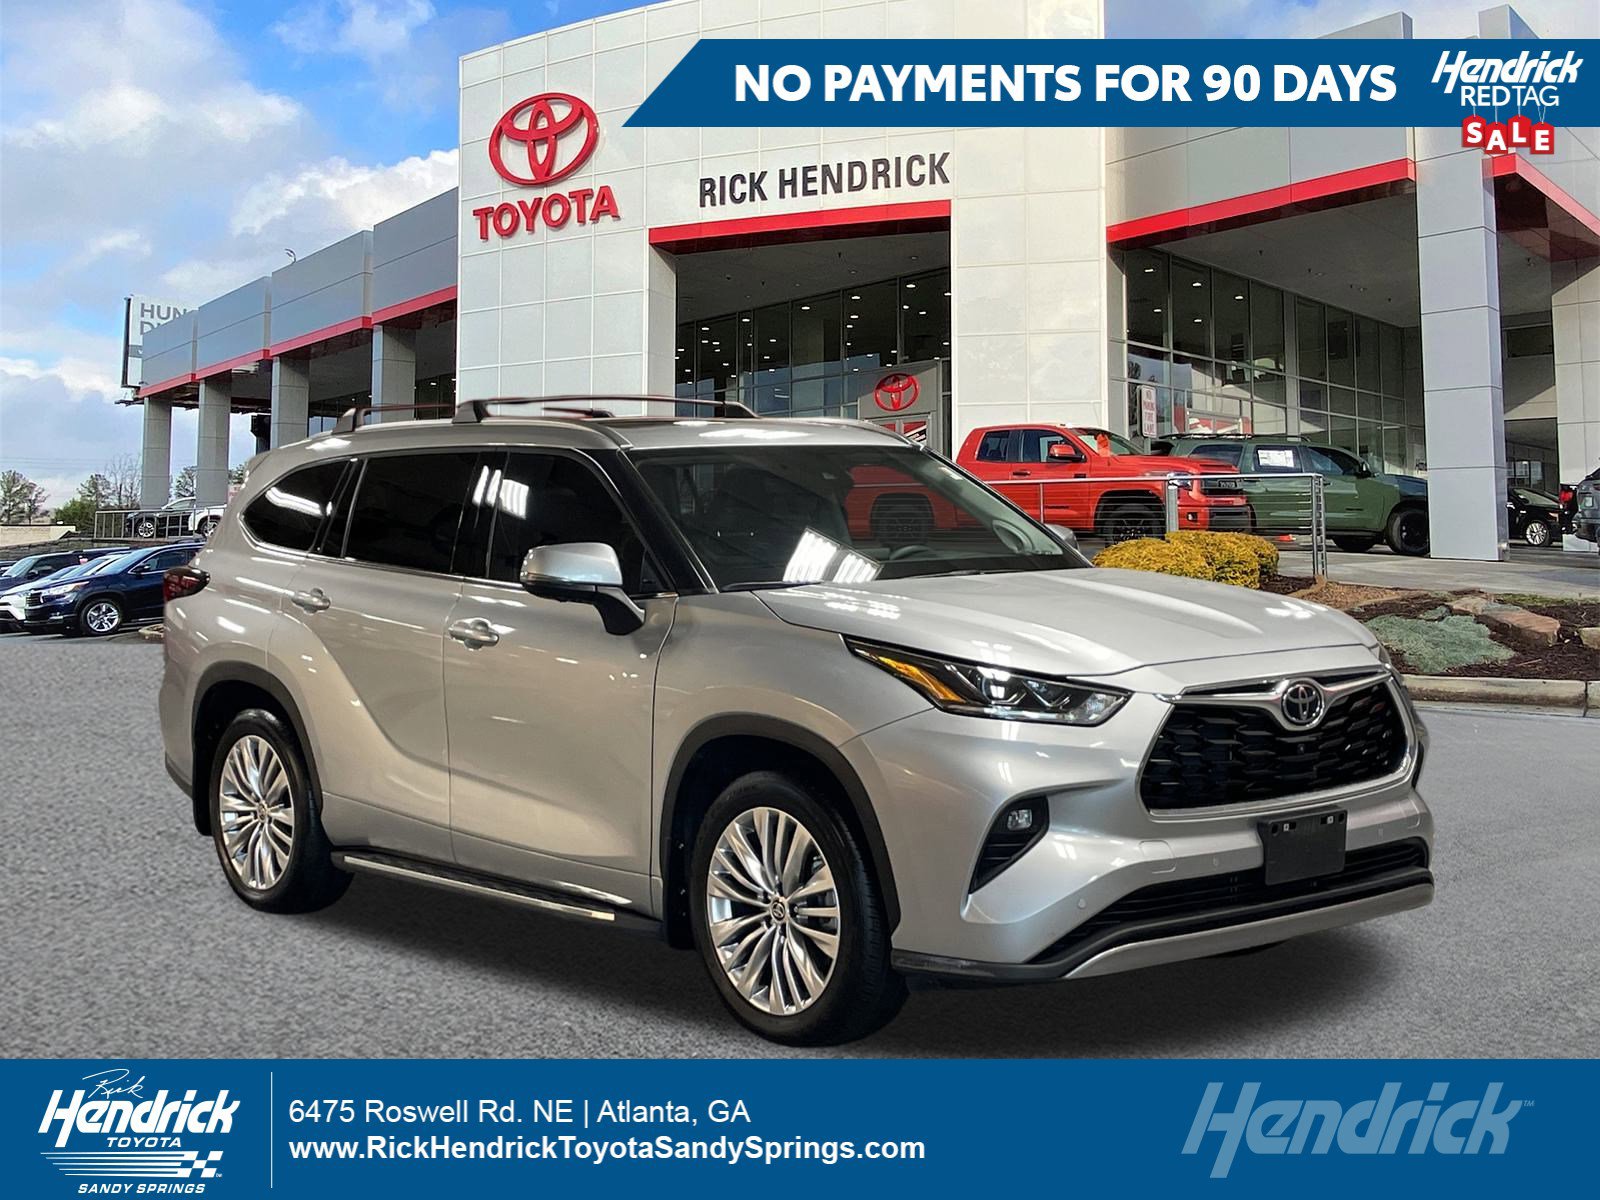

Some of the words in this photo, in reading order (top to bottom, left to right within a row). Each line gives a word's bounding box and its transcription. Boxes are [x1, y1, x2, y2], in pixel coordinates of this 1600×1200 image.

[699, 170, 768, 208] RICK
[778, 152, 951, 199] HENDRICK
[473, 185, 620, 240] TOYOTA
